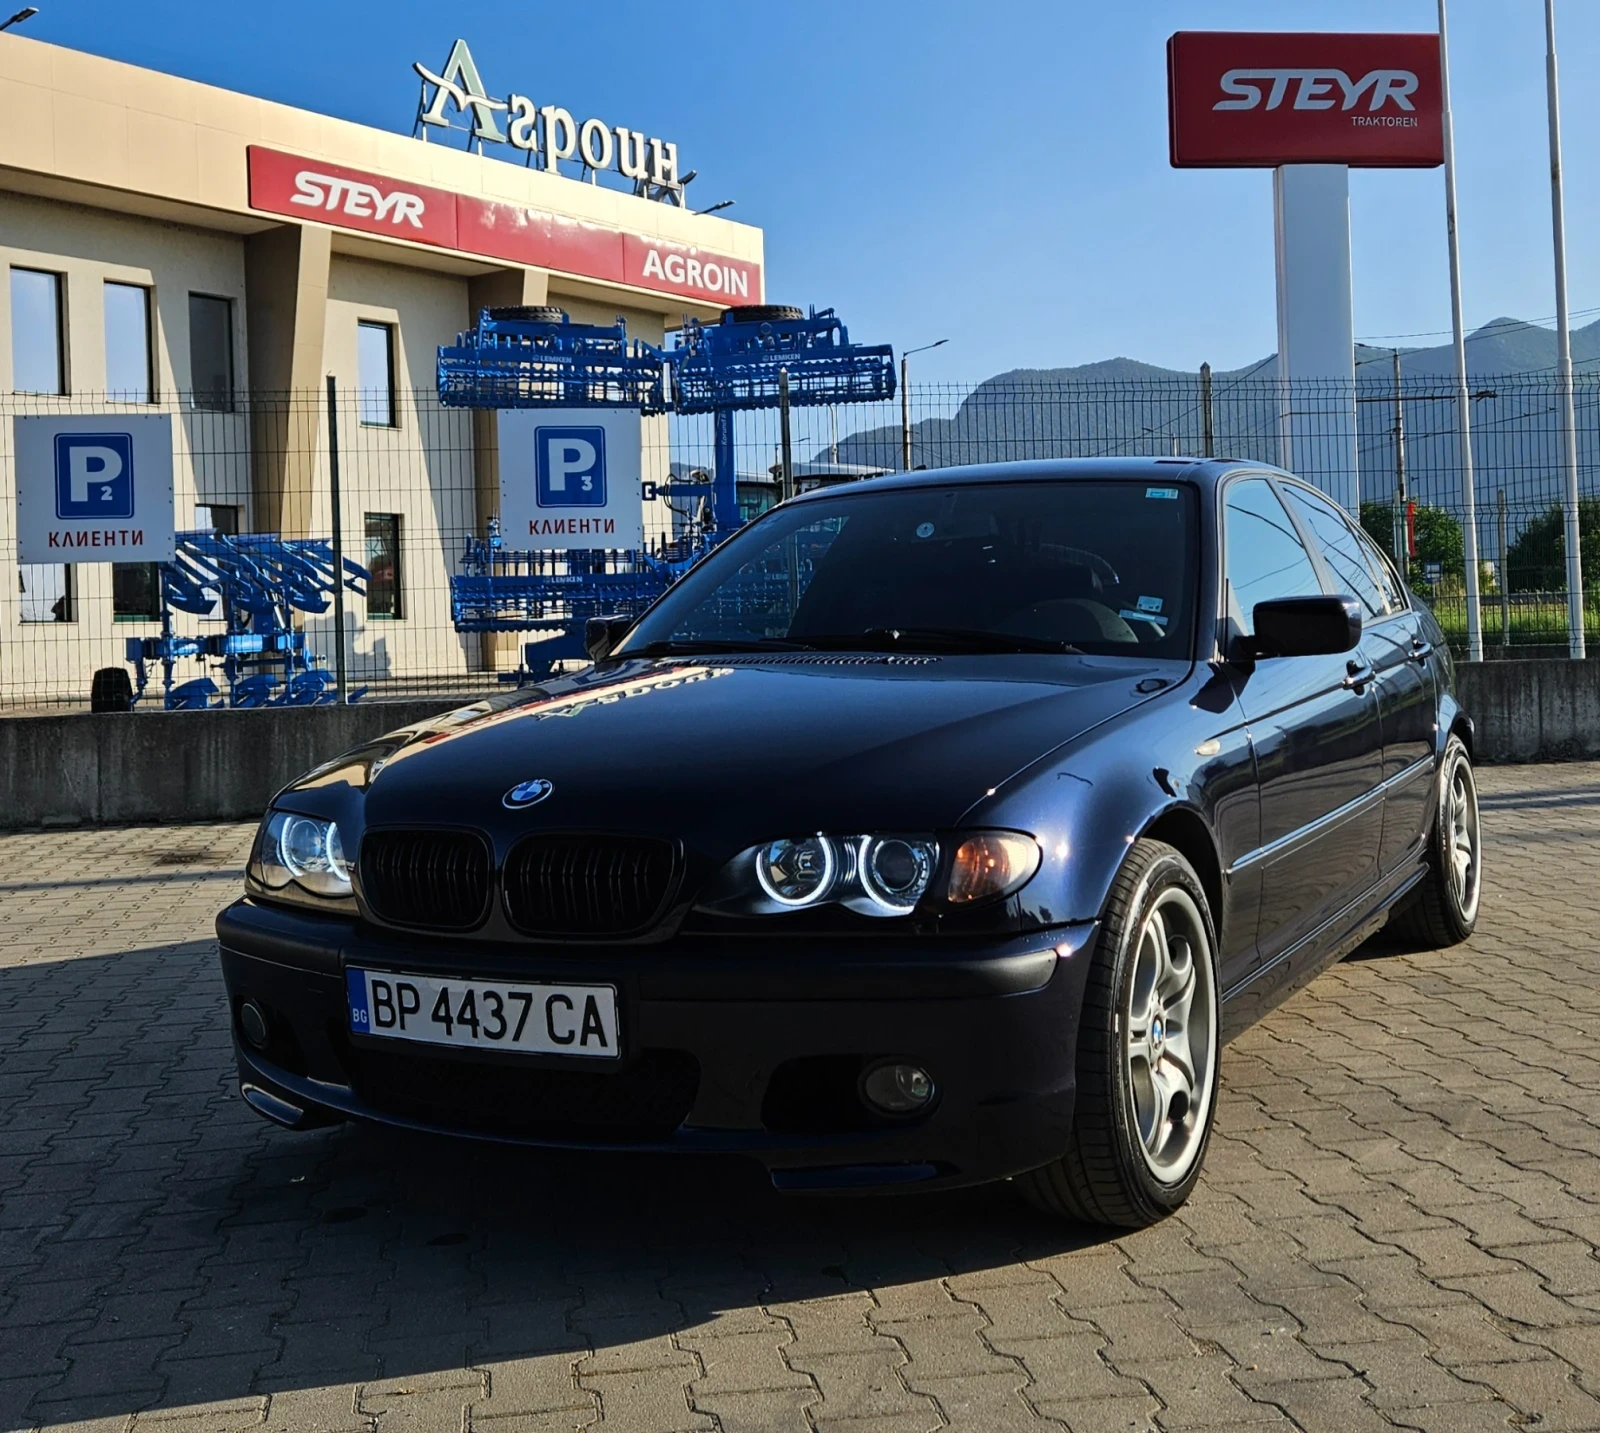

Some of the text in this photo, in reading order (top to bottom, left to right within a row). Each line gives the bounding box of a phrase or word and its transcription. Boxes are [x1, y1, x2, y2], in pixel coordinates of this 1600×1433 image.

[1212, 68, 1420, 111] STEYR
[1351, 116, 1419, 127] TRAKTOREN
[290, 170, 426, 229] STEYR
[642, 248, 749, 298] AGROIN
[540, 355, 572, 364] LEMKEN
[770, 353, 801, 361] LEMKEN
[529, 518, 615, 535] КЛИЕНТИ
[48, 529, 144, 548] КЛИЕНТИ
[352, 1007, 368, 1024] BG
[370, 979, 609, 1048] BP 4437 CA
